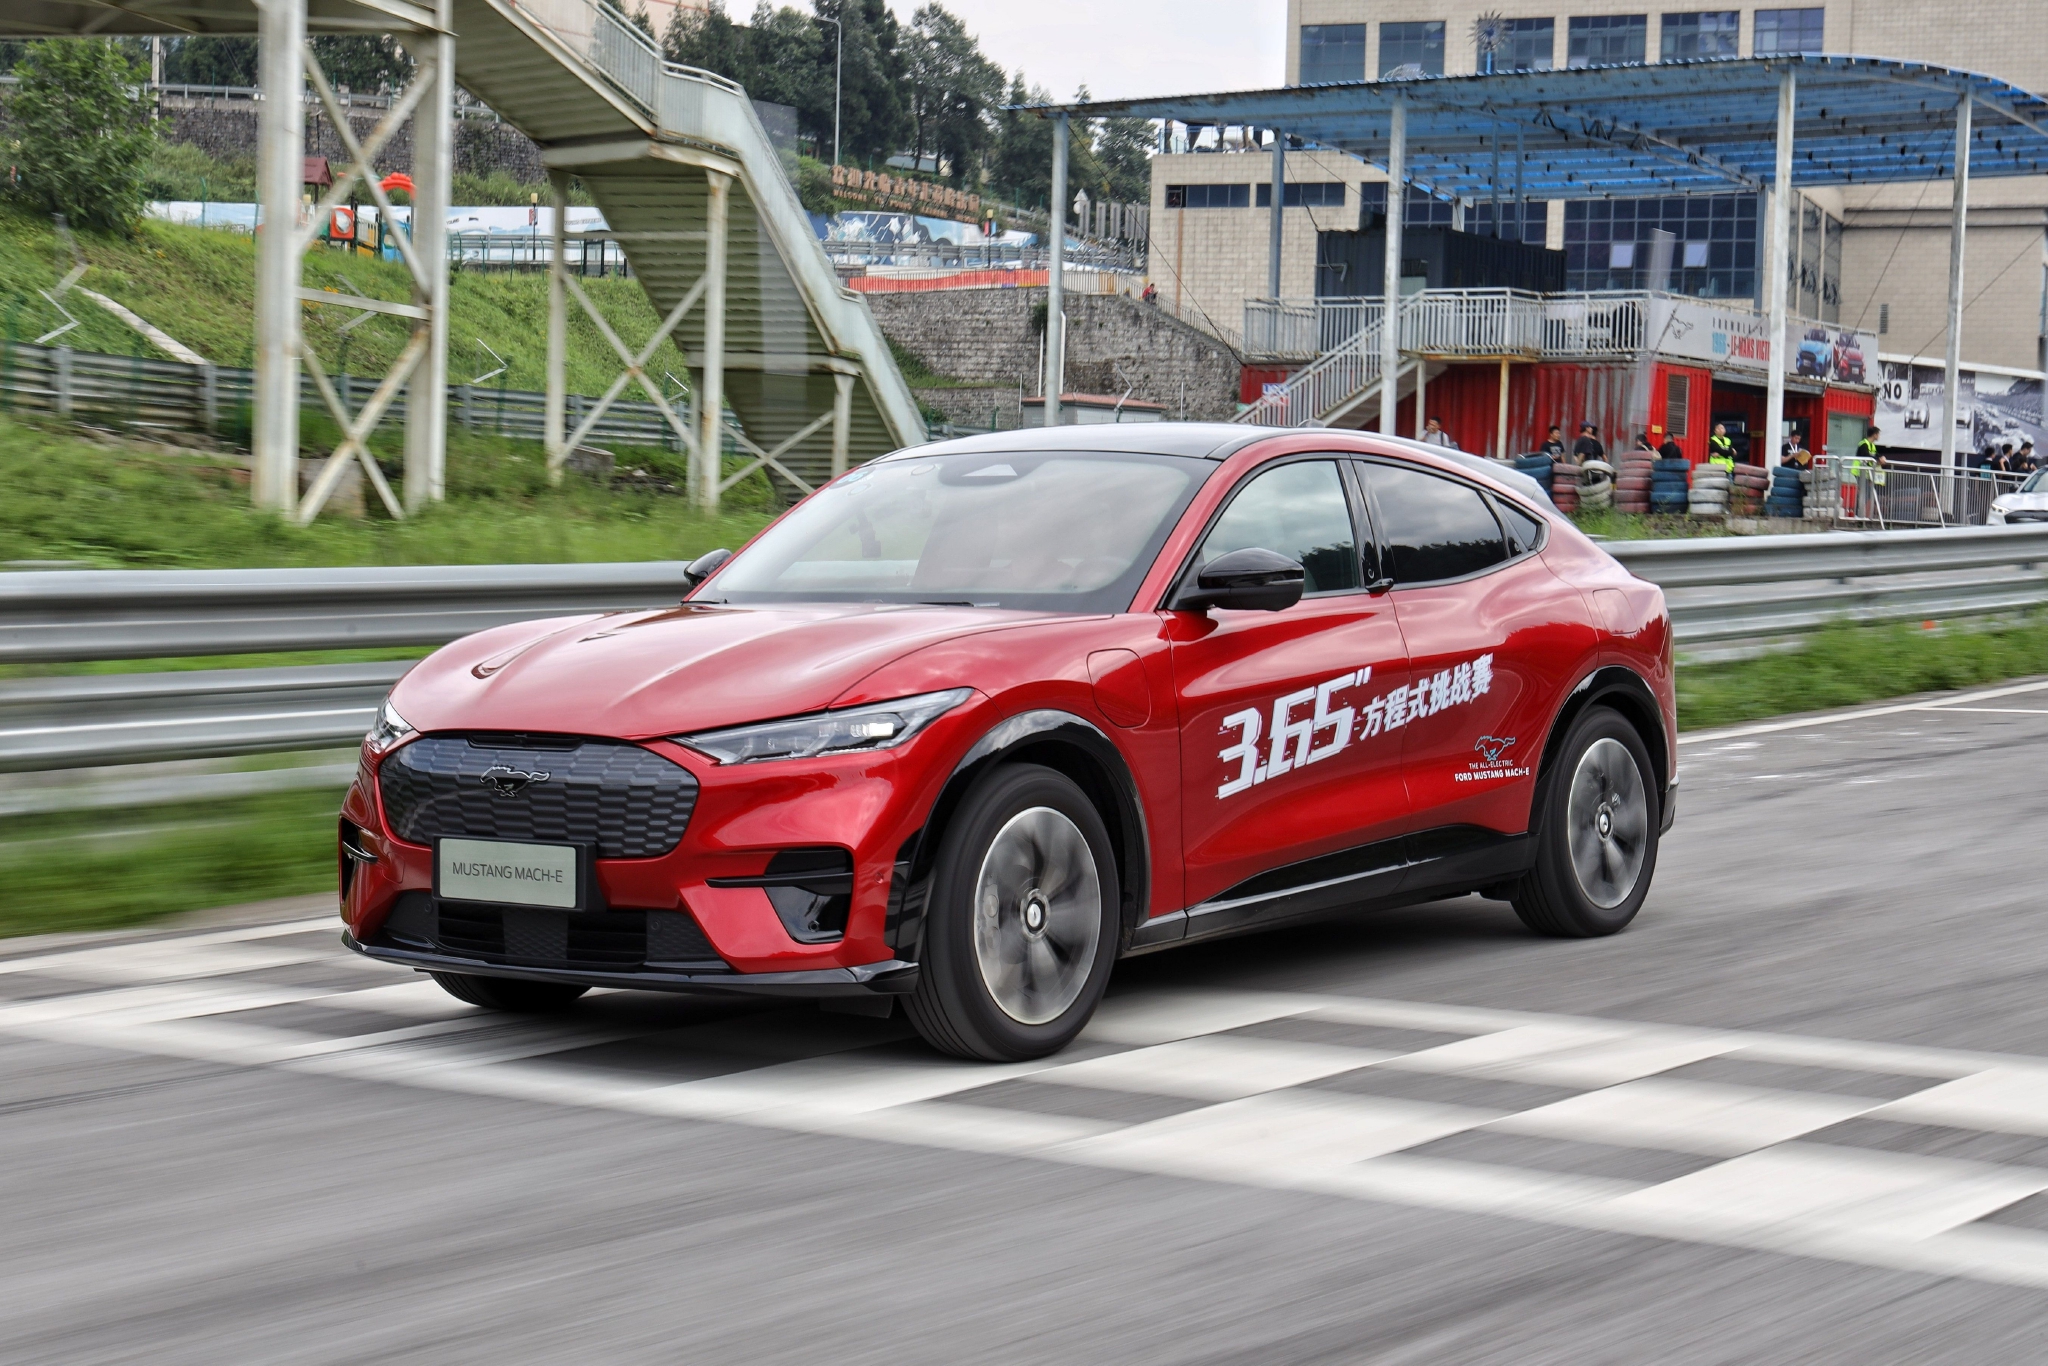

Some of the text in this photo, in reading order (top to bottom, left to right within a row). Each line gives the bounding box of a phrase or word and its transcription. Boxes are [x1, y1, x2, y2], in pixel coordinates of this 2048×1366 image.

[1883, 382, 1903, 400] NO
[1359, 652, 1494, 741] 方程式挑战赛
[1468, 759, 1513, 770] THE ALL-ELECTRIC
[1454, 766, 1530, 782] FORD MUSTANG MACH-E
[452, 862, 563, 883] MUSTANG MACH-E
